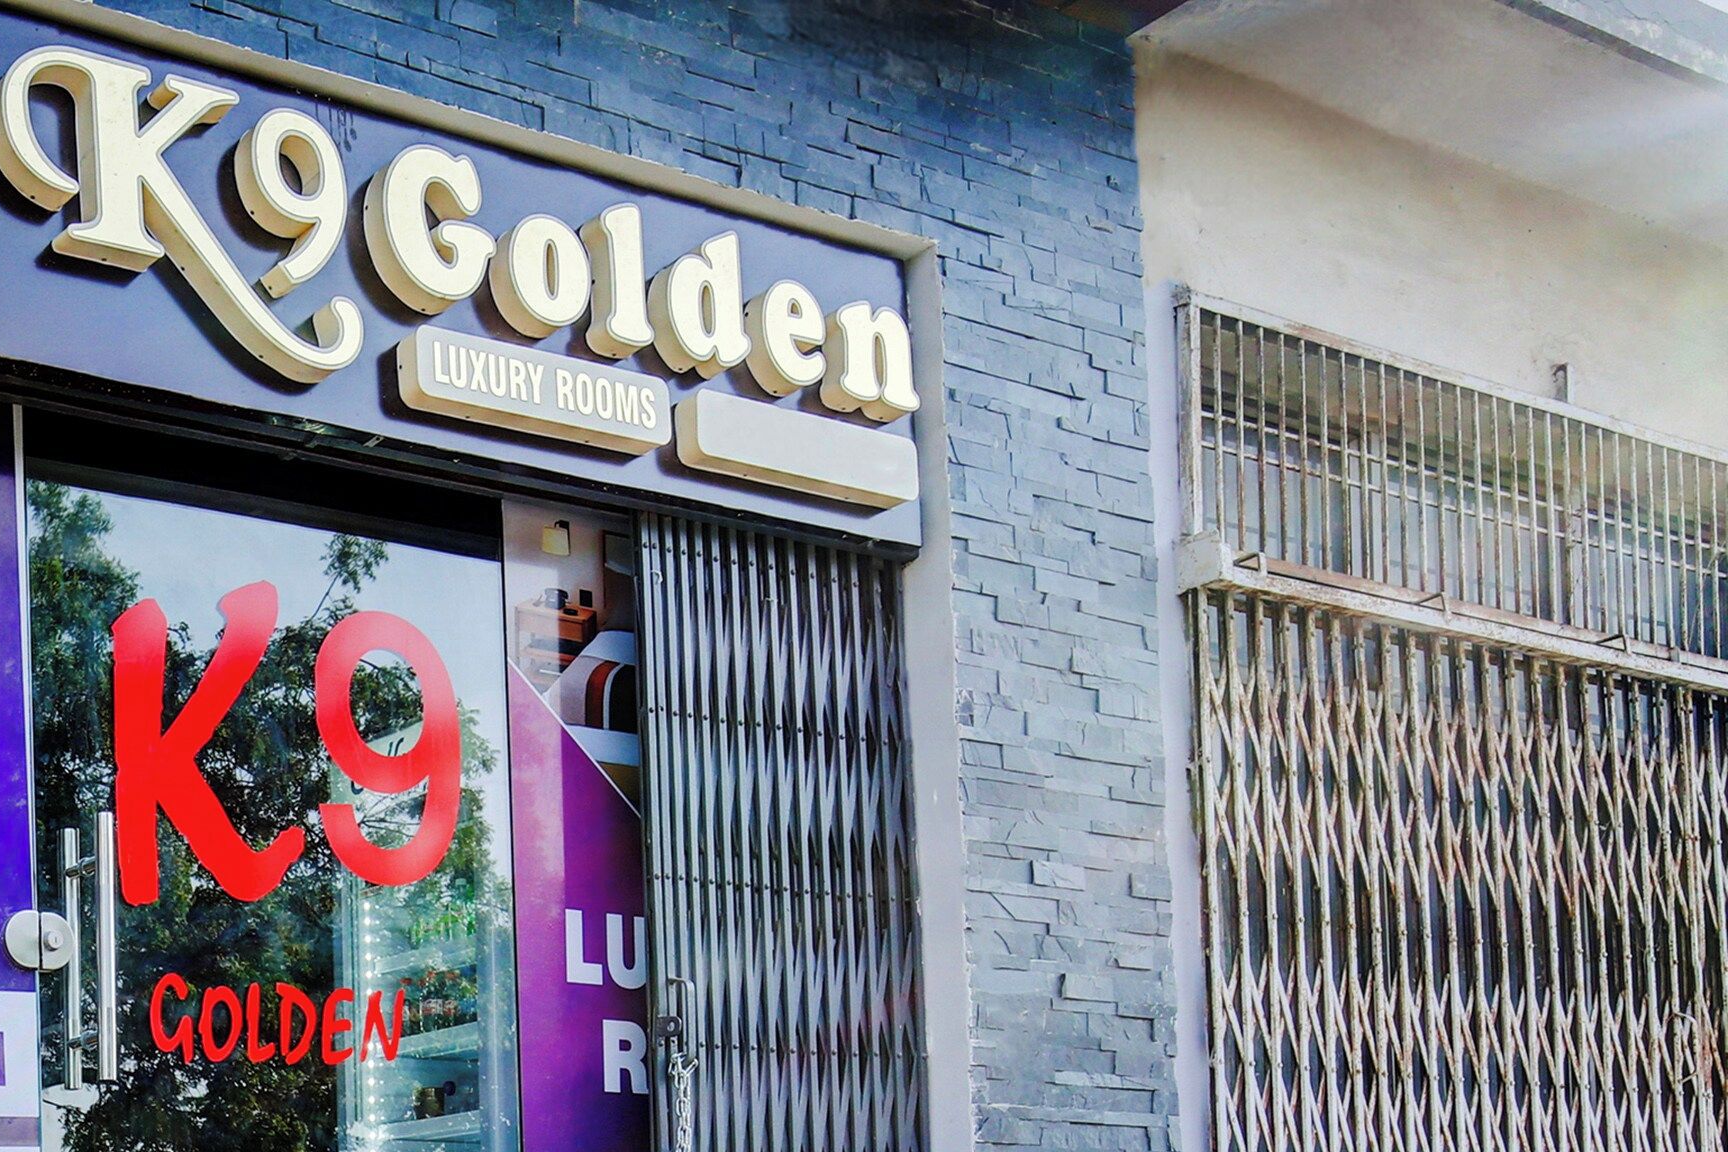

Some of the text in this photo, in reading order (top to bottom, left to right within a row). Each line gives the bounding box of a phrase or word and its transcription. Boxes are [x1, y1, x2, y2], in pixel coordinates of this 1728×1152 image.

[366, 144, 920, 420] Golden
[432, 340, 658, 430] LUXURY ROOMS
[110, 579, 462, 907] K9
[149, 972, 406, 1066] GOLDEN
